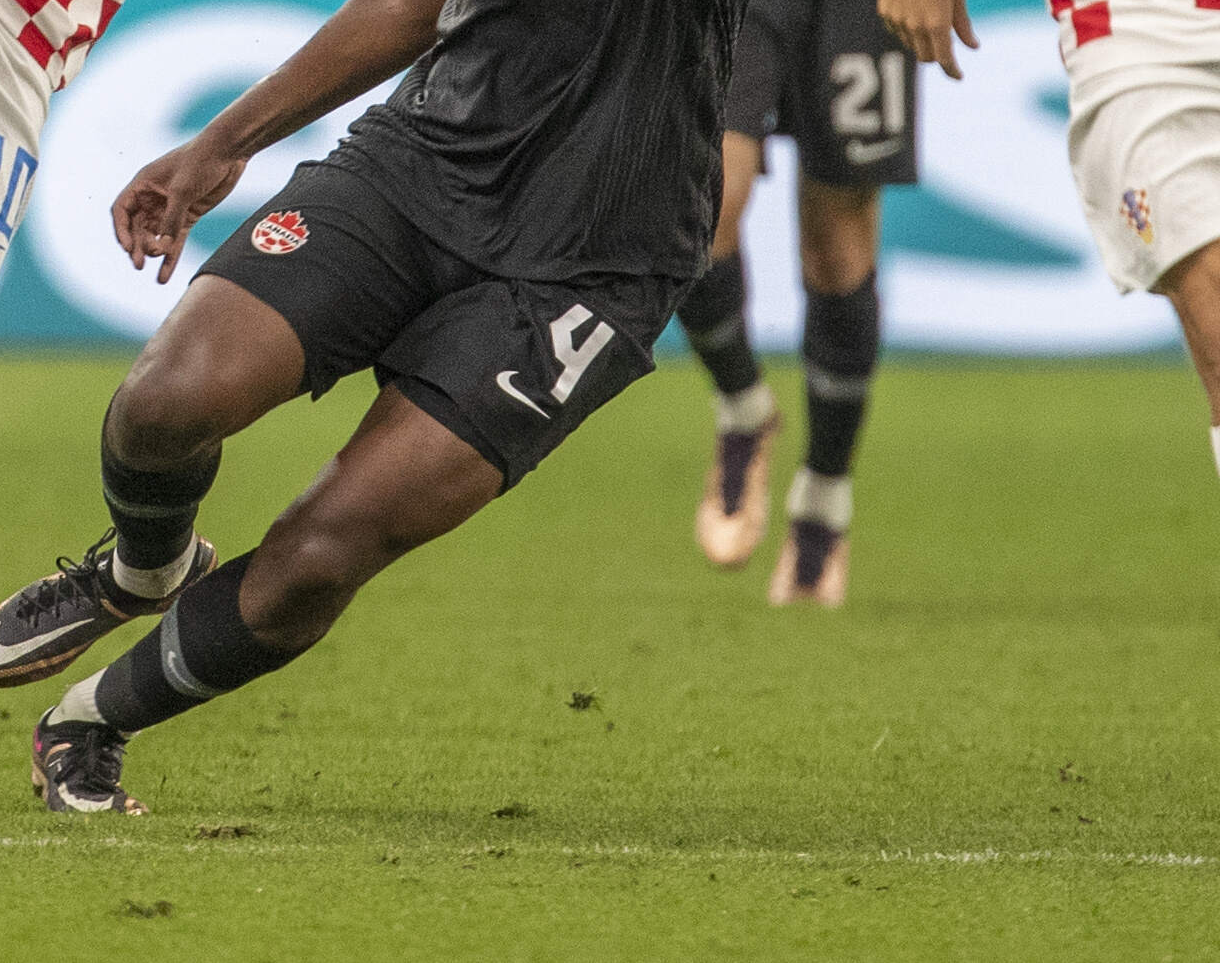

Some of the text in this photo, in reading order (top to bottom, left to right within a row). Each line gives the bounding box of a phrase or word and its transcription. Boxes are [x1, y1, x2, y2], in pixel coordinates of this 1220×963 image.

[830, 51, 905, 134] 21
[260, 221, 300, 245] CANADA
[549, 303, 616, 404] 4
